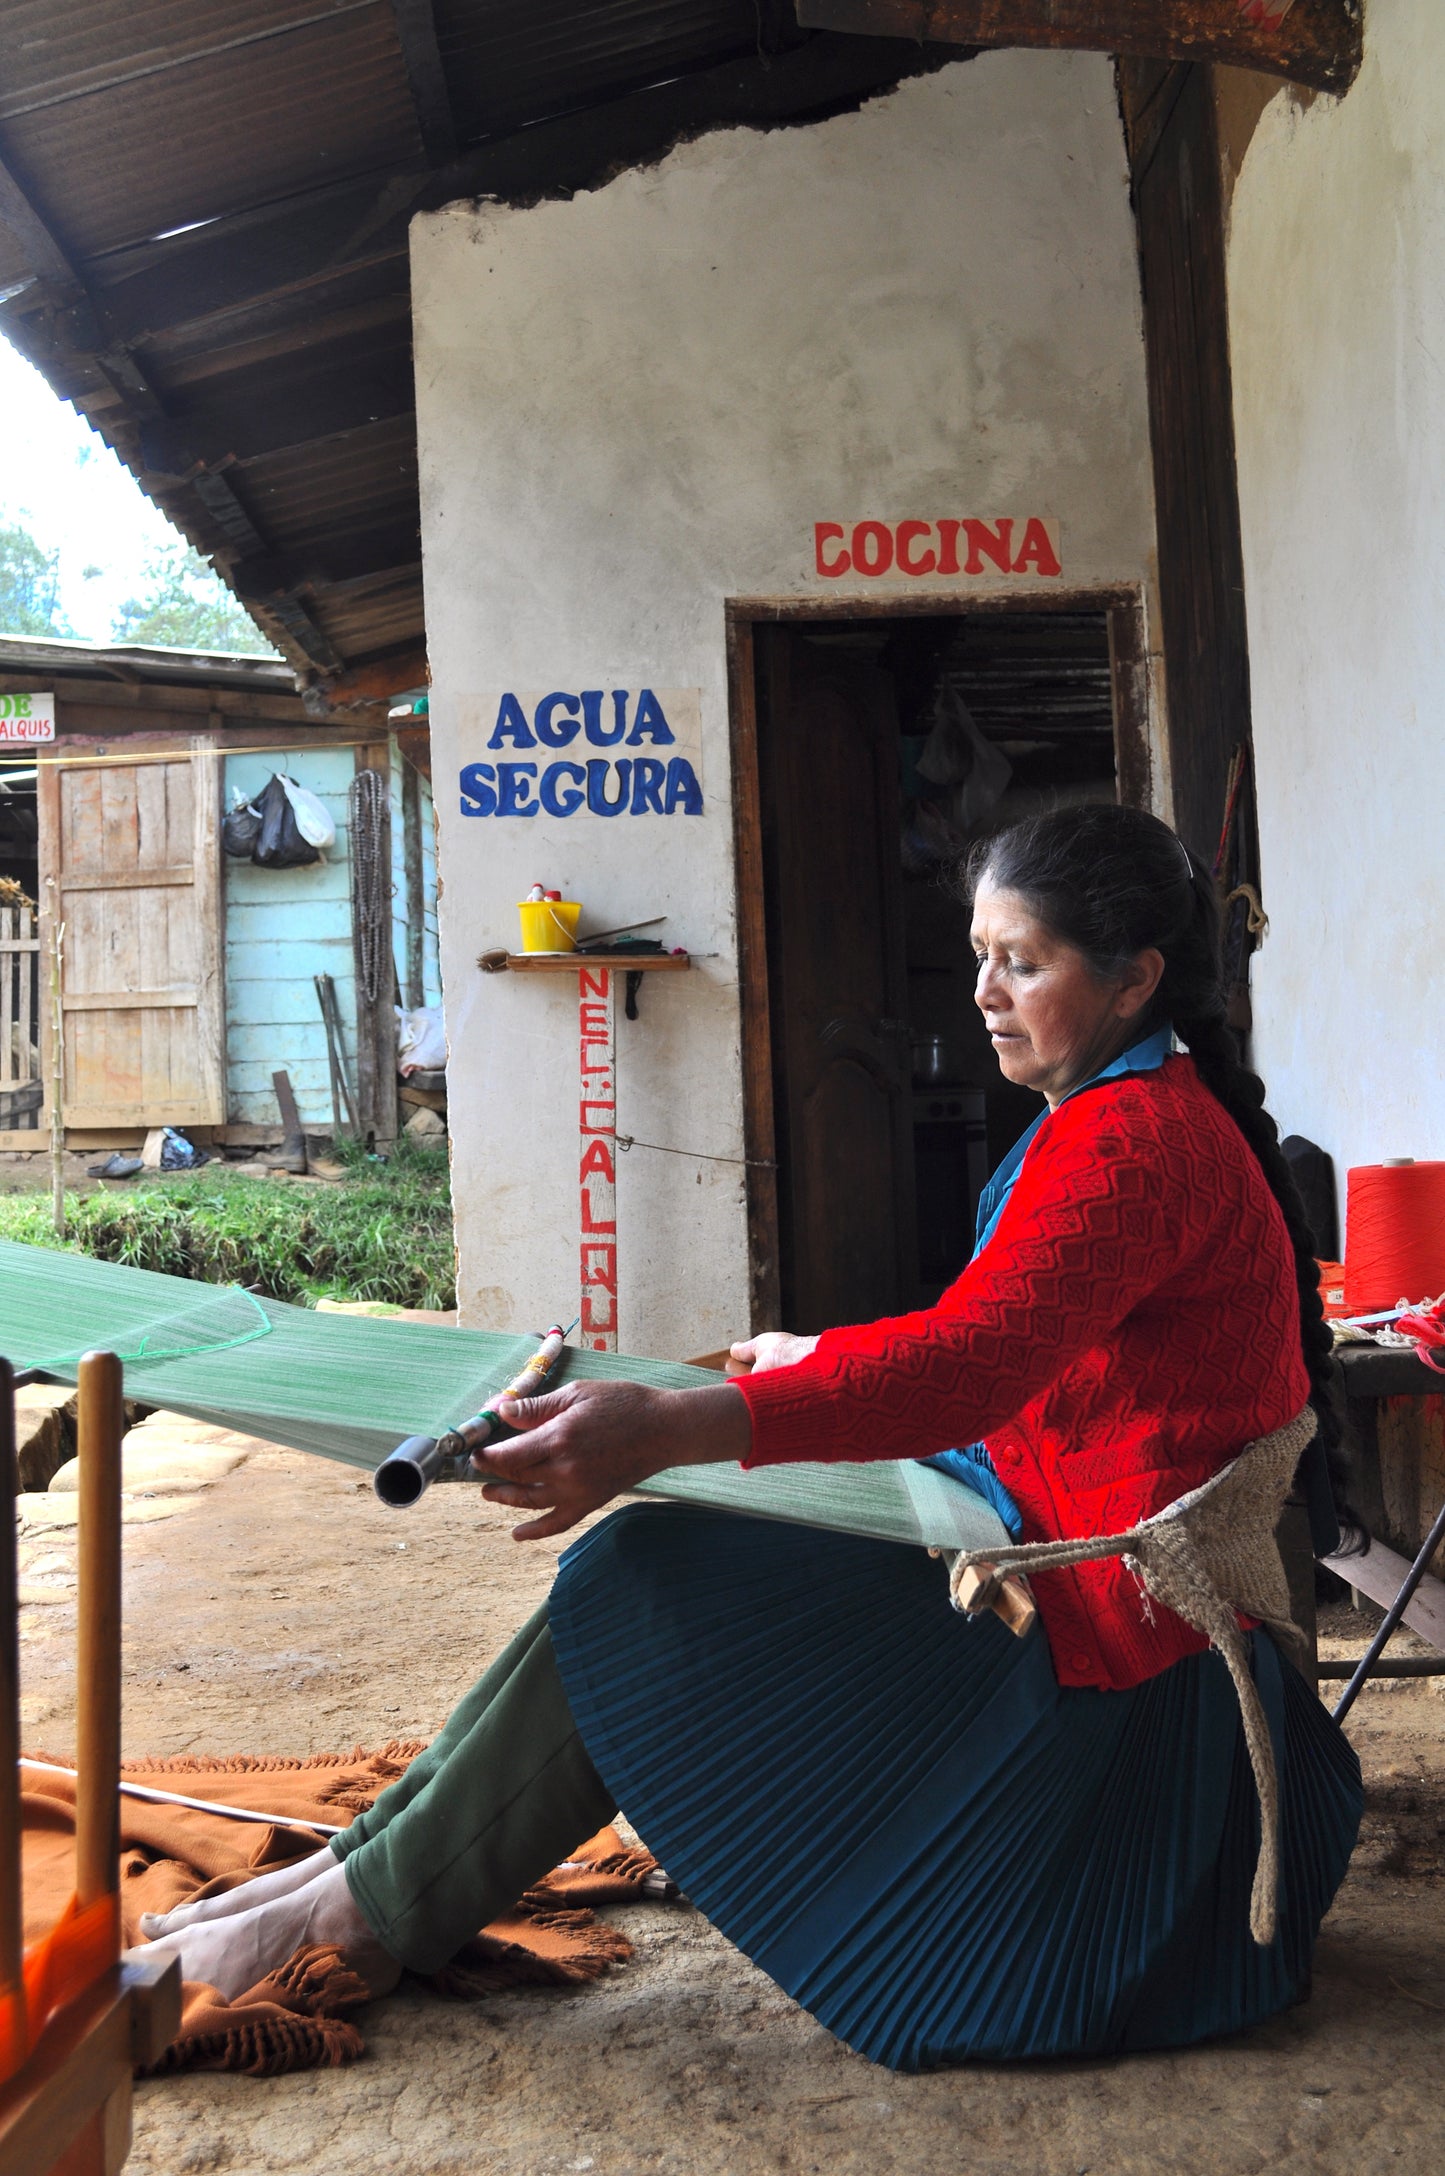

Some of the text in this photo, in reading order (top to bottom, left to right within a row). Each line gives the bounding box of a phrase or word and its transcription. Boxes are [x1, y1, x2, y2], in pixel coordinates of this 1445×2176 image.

[814, 517, 1062, 577] COCINA
[486, 688, 676, 750] AGUA
[459, 756, 704, 818] SEGURA
